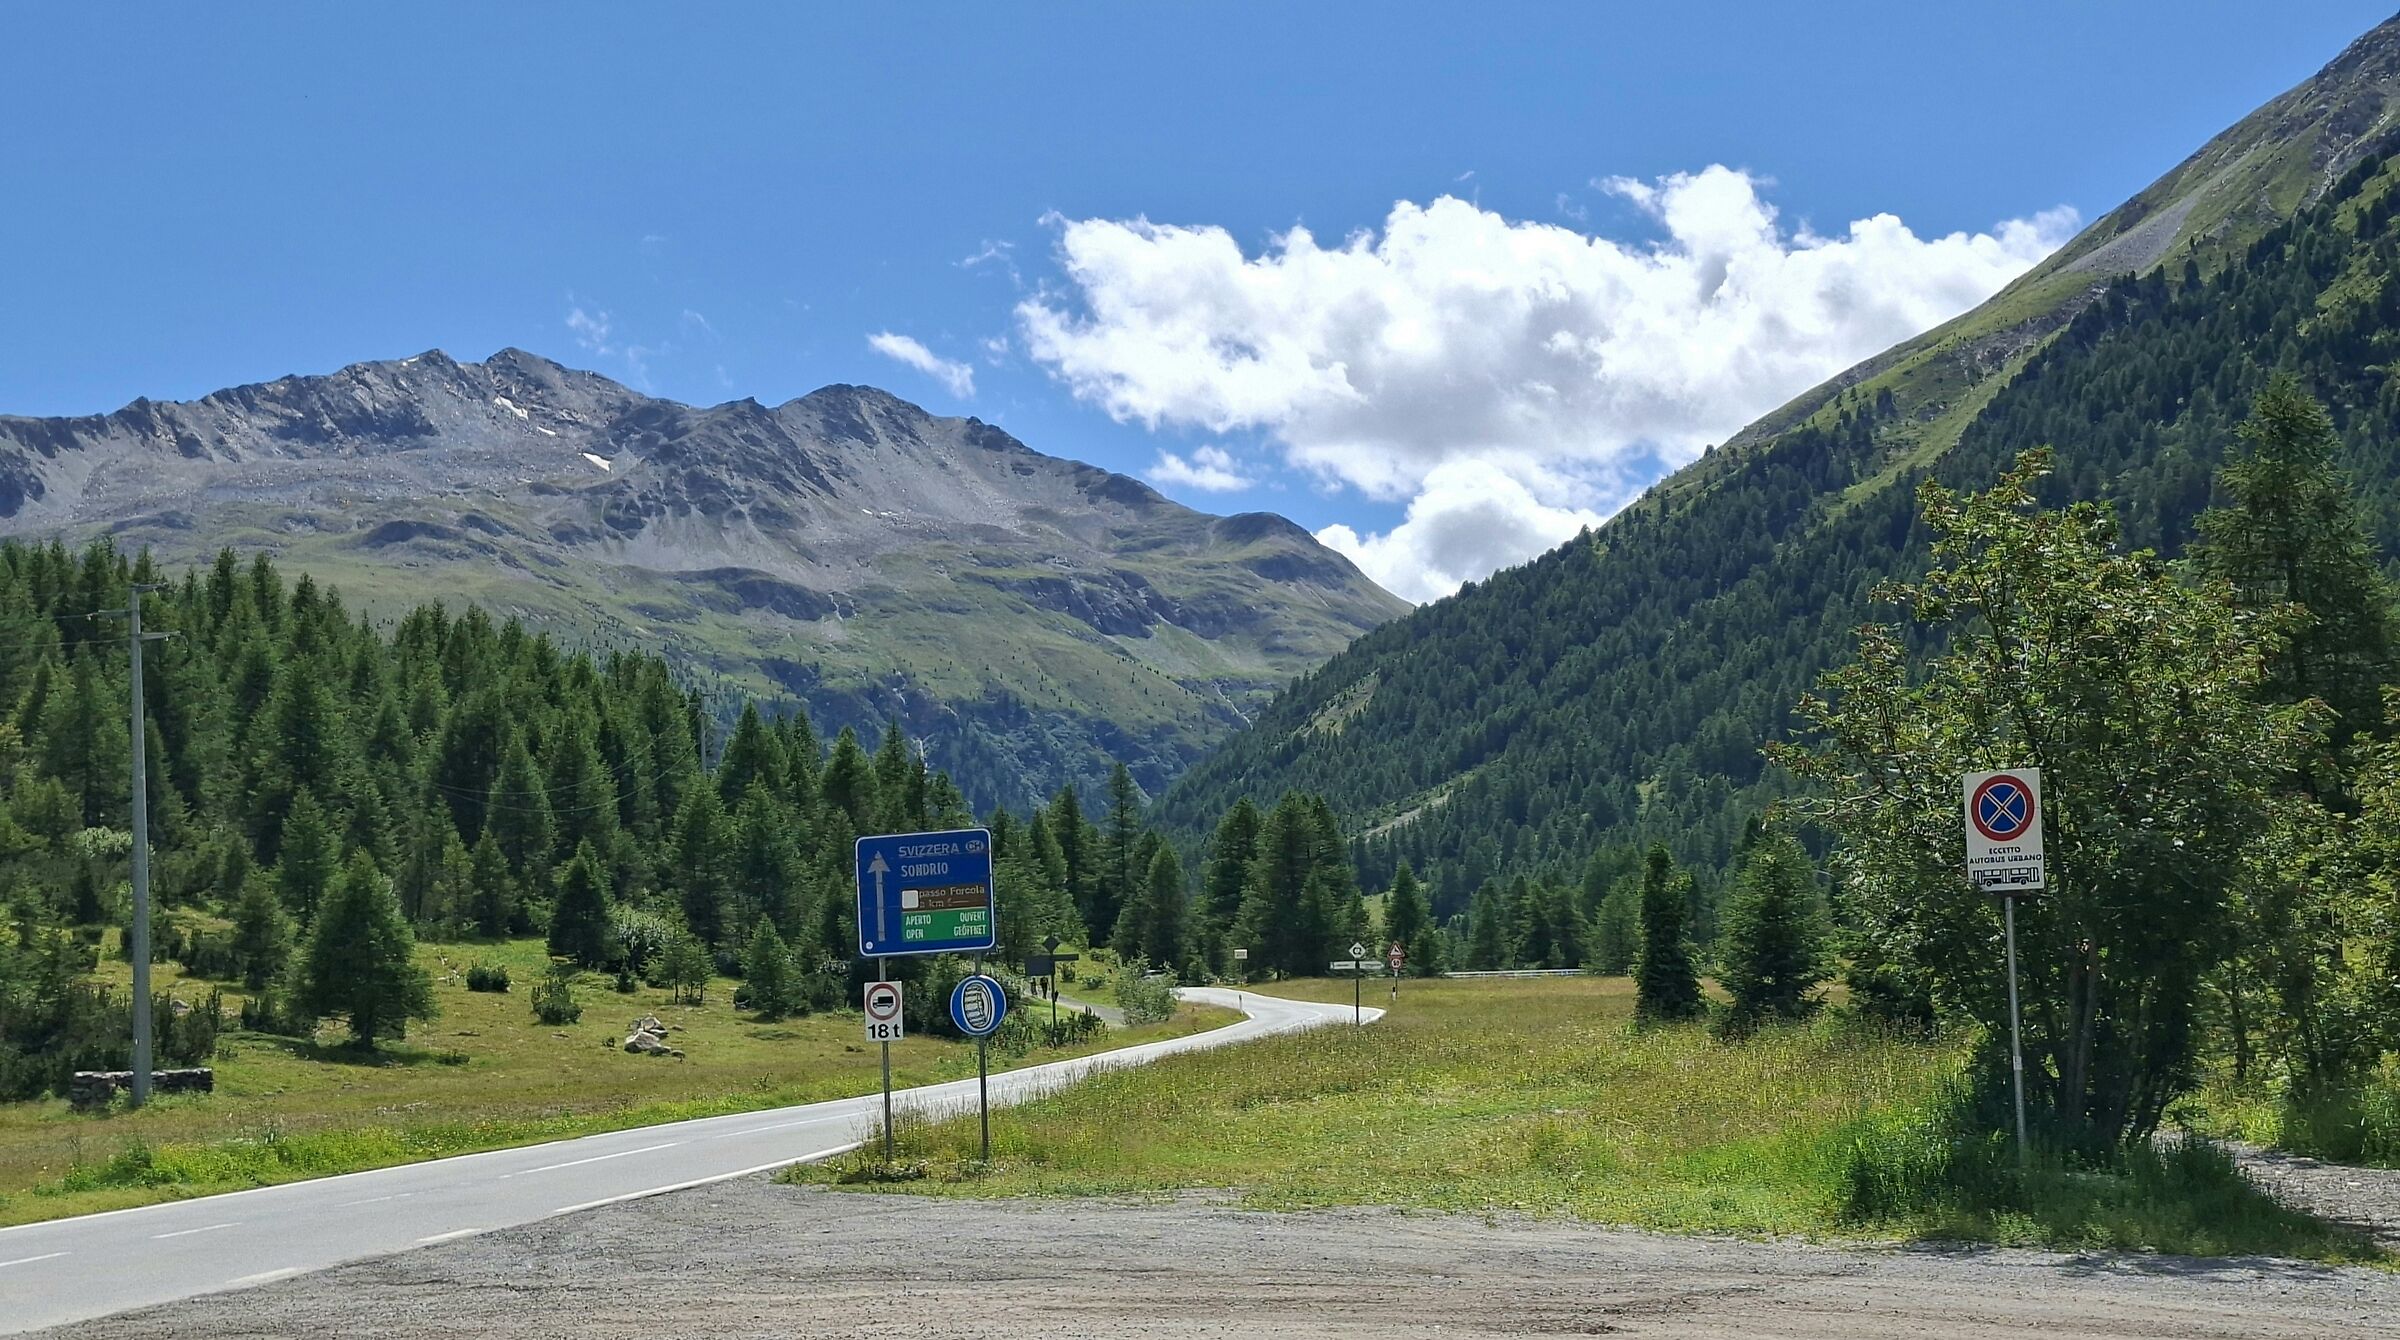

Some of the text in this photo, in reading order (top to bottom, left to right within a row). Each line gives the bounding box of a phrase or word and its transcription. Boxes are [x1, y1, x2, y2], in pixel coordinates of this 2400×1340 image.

[898, 843, 960, 857] SVIZZERA
[1989, 846, 2021, 854] ECCETTO
[1969, 854, 2042, 864] AUTOBUS URBANO
[901, 862, 948, 877] SONDRIO
[919, 885, 985, 898] passo Forcola
[928, 899, 944, 908] km
[906, 914, 932, 926] APERTO
[960, 911, 986, 922] OUVERT
[906, 929, 924, 939] OPEN
[953, 924, 986, 937] GEÖFFNET
[868, 1024, 900, 1039] 18 t
